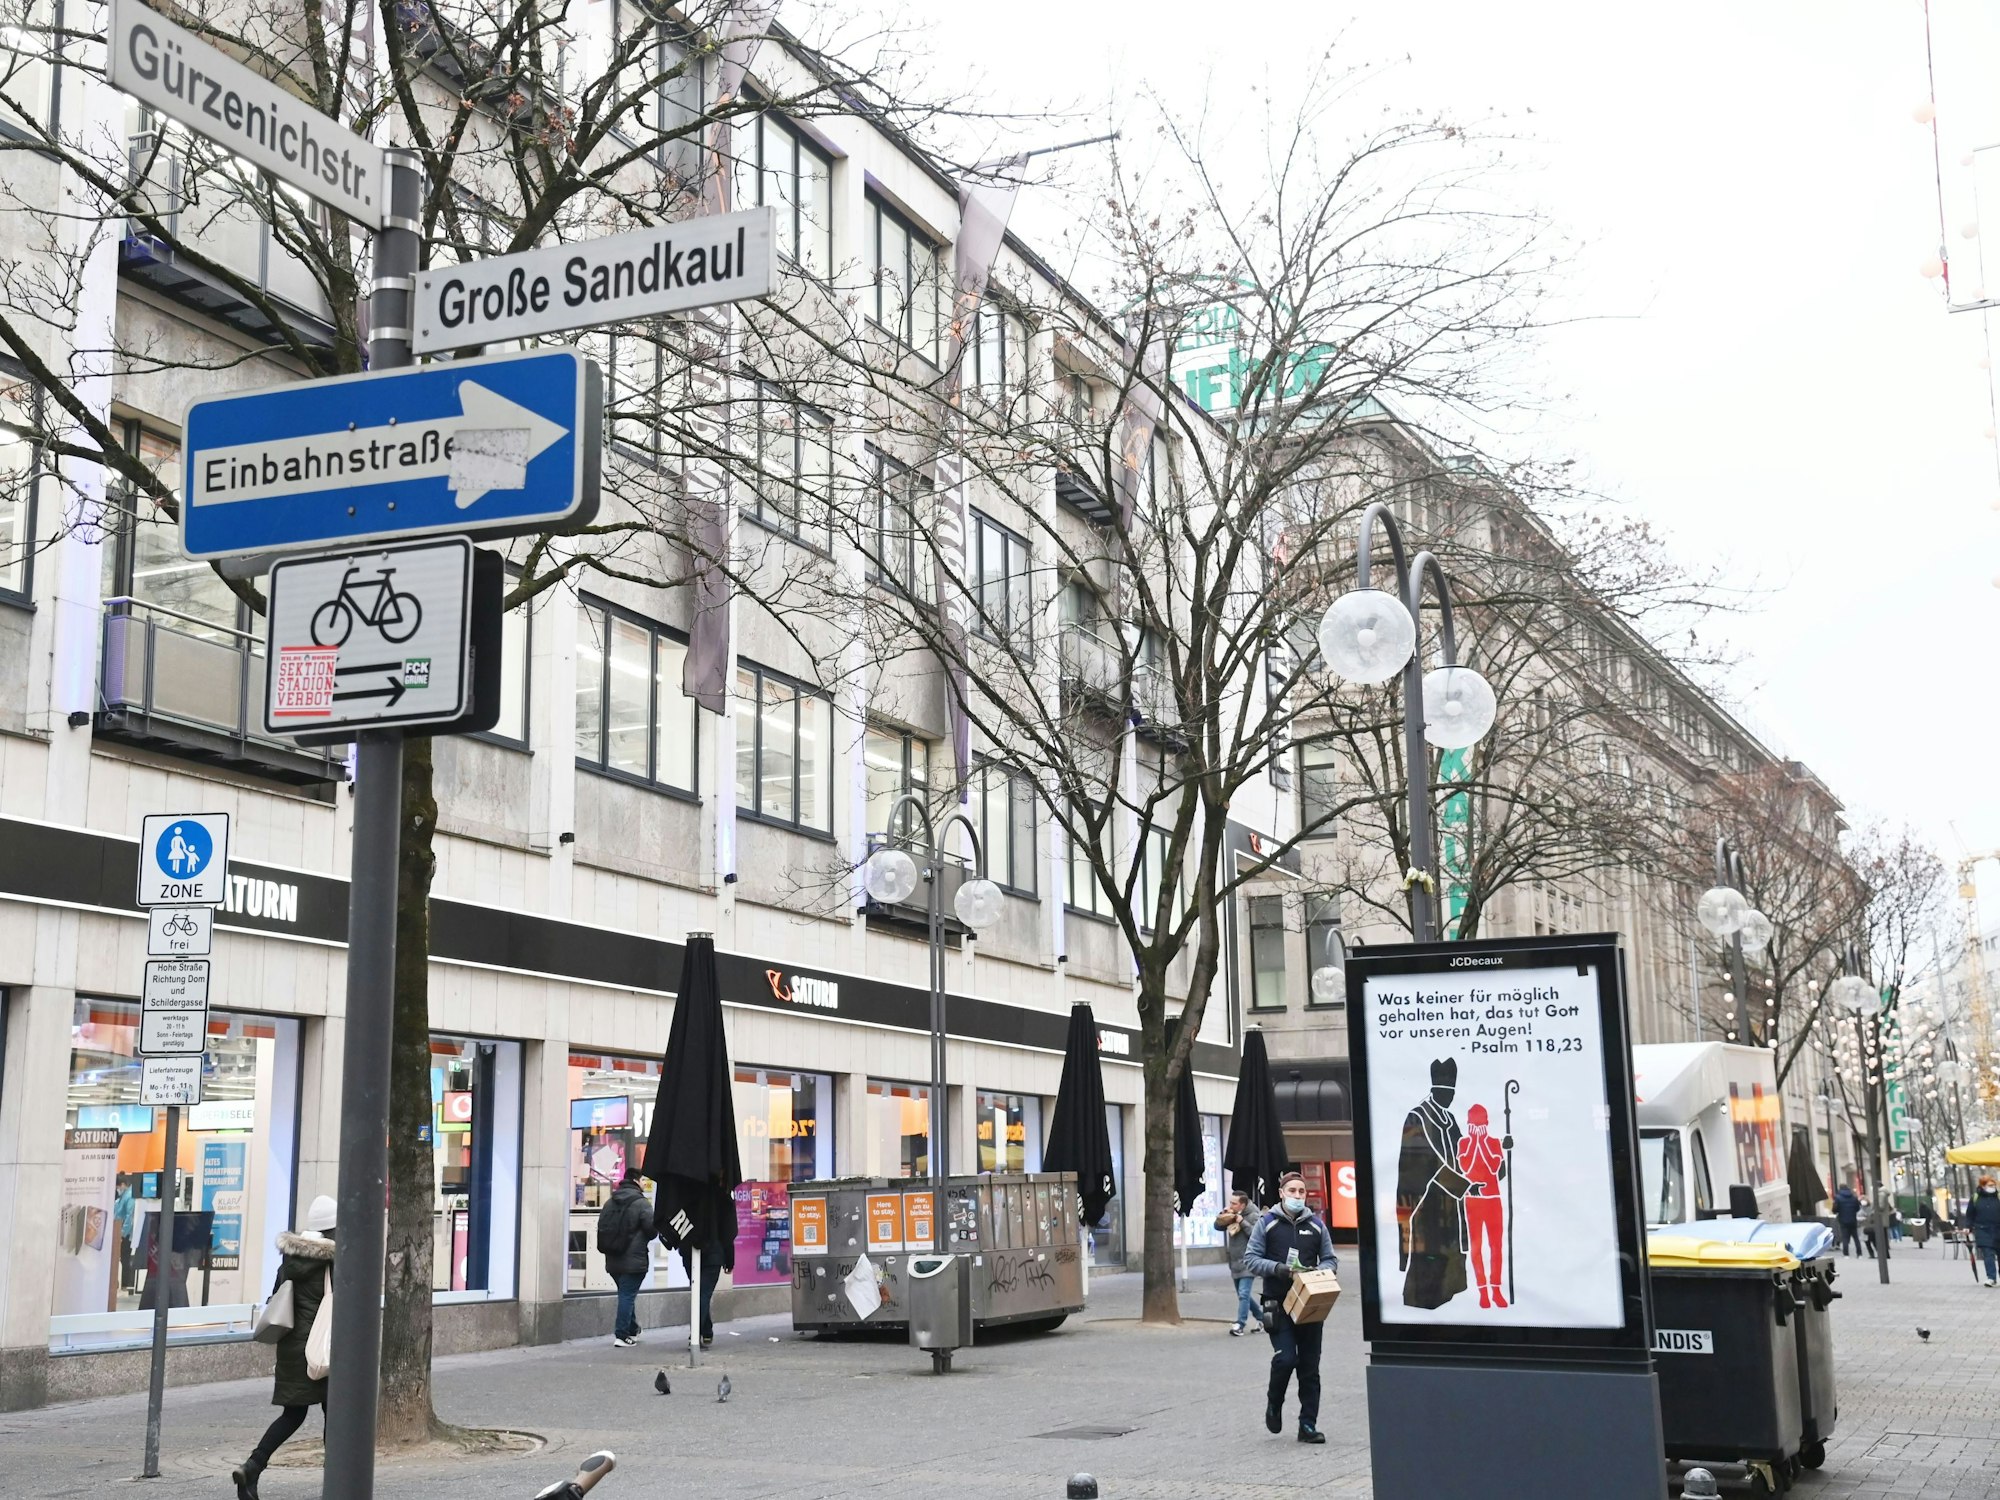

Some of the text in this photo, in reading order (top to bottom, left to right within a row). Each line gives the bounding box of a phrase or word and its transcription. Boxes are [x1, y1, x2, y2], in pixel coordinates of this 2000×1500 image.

[129, 23, 371, 205] Gürzenichstr.
[439, 227, 745, 329] Große Sandkaul
[280, 662, 335, 676] SEKTION
[406, 662, 429, 674] FCK
[278, 677, 333, 691] STADION
[278, 692, 332, 706] VERBOT
[160, 884, 203, 899] ZONE
[215, 874, 298, 922] ATURN
[170, 939, 189, 949] frei
[179, 963, 203, 971] Straße
[1450, 956, 1503, 967] JCDecaux
[152, 974, 206, 985] Richtung Dom
[171, 987, 185, 995] und
[790, 975, 838, 1009] SATURN
[1378, 986, 1559, 1005] Was keiner für möglich
[151, 998, 203, 1008] Schildergasse
[1379, 1004, 1580, 1026] gehalten hat, das tut Gott
[172, 1031, 193, 1039] Feiertags
[1379, 1022, 1532, 1040] vor unseren Augen!
[1472, 1040, 1518, 1053] Psalm
[1526, 1038, 1583, 1053] 118,23
[75, 1131, 117, 1144] SATURN
[212, 1257, 238, 1268] SATURN
[1657, 1332, 1704, 1350] NDIS
